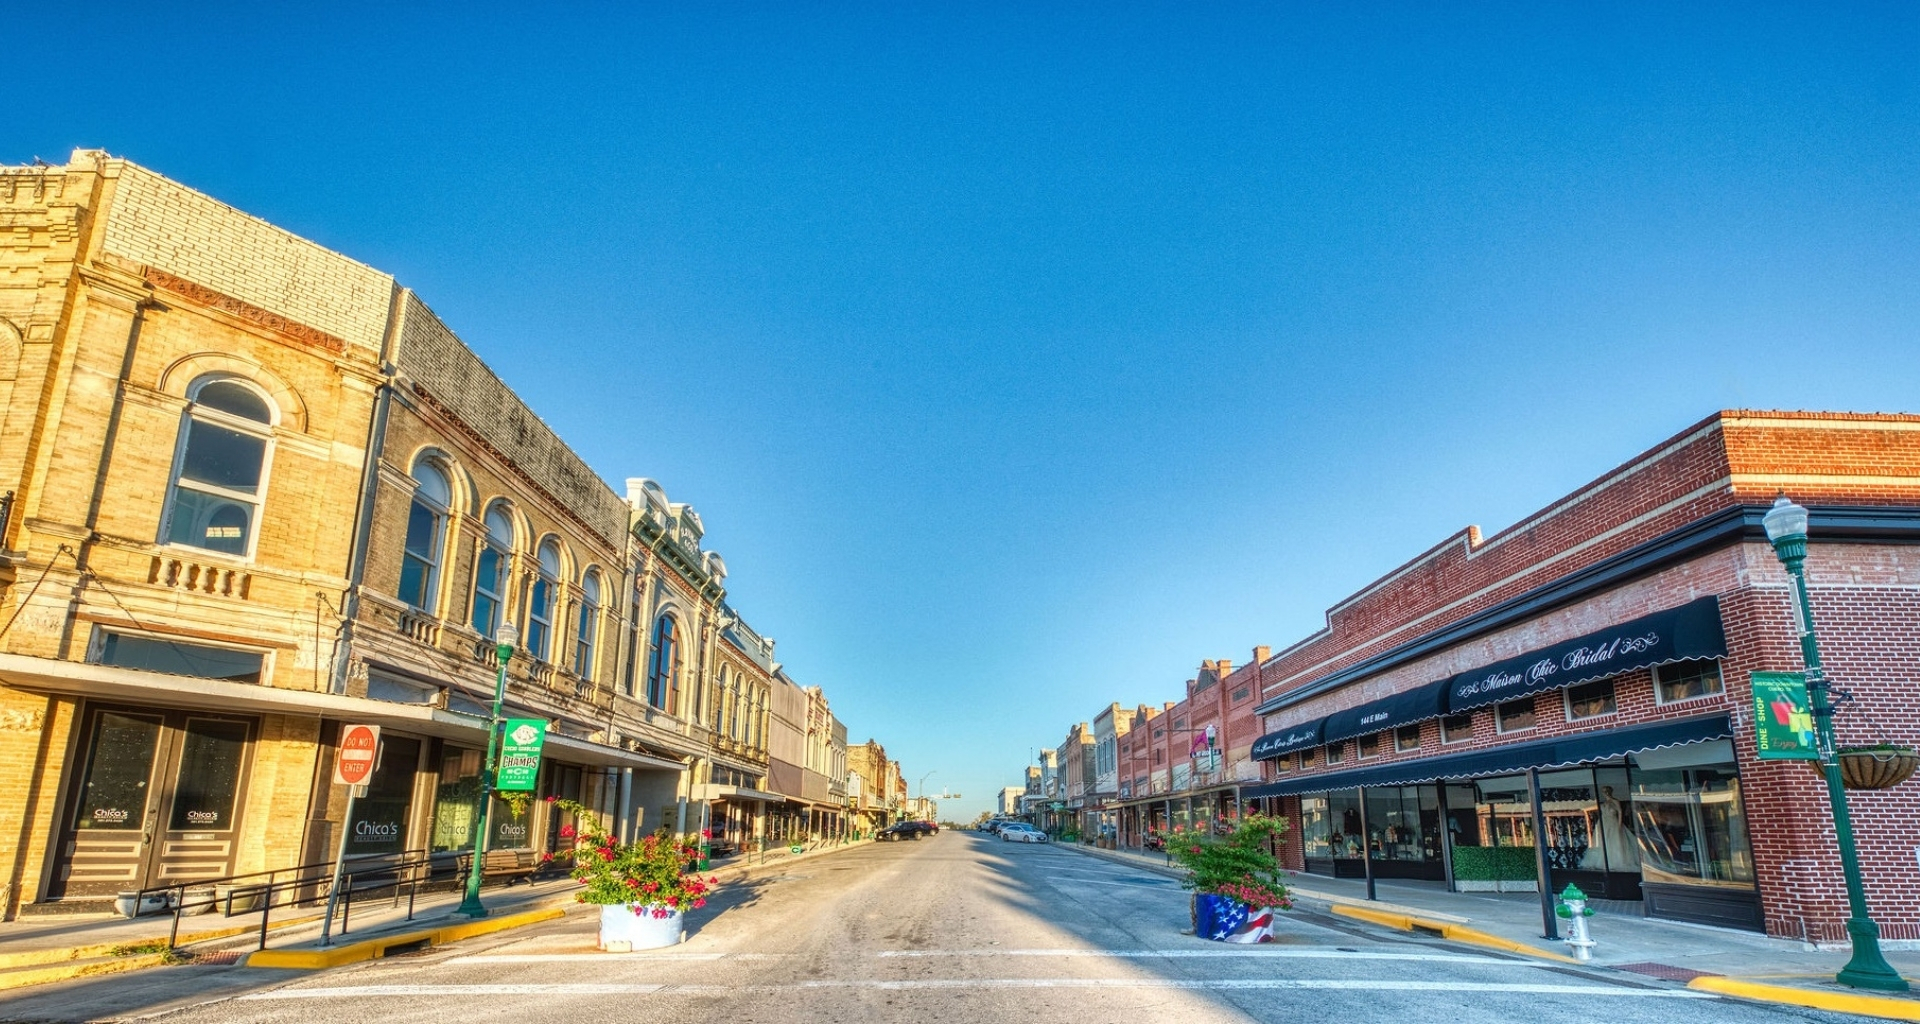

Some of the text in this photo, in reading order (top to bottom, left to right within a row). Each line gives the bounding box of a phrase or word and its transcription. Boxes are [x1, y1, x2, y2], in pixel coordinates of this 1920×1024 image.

[1481, 638, 1621, 693] Maison Chic Bridal
[1360, 712, 1388, 725] 144 E Main
[1755, 696, 1769, 750] DINE SHOP
[347, 737, 372, 747] DO NOT
[344, 763, 366, 773] ENTER
[502, 755, 539, 769] CHAMPS
[94, 809, 128, 817] Chica's
[187, 810, 218, 818] Chica's
[355, 820, 398, 835] Chica's
[500, 823, 526, 835] Chica's
